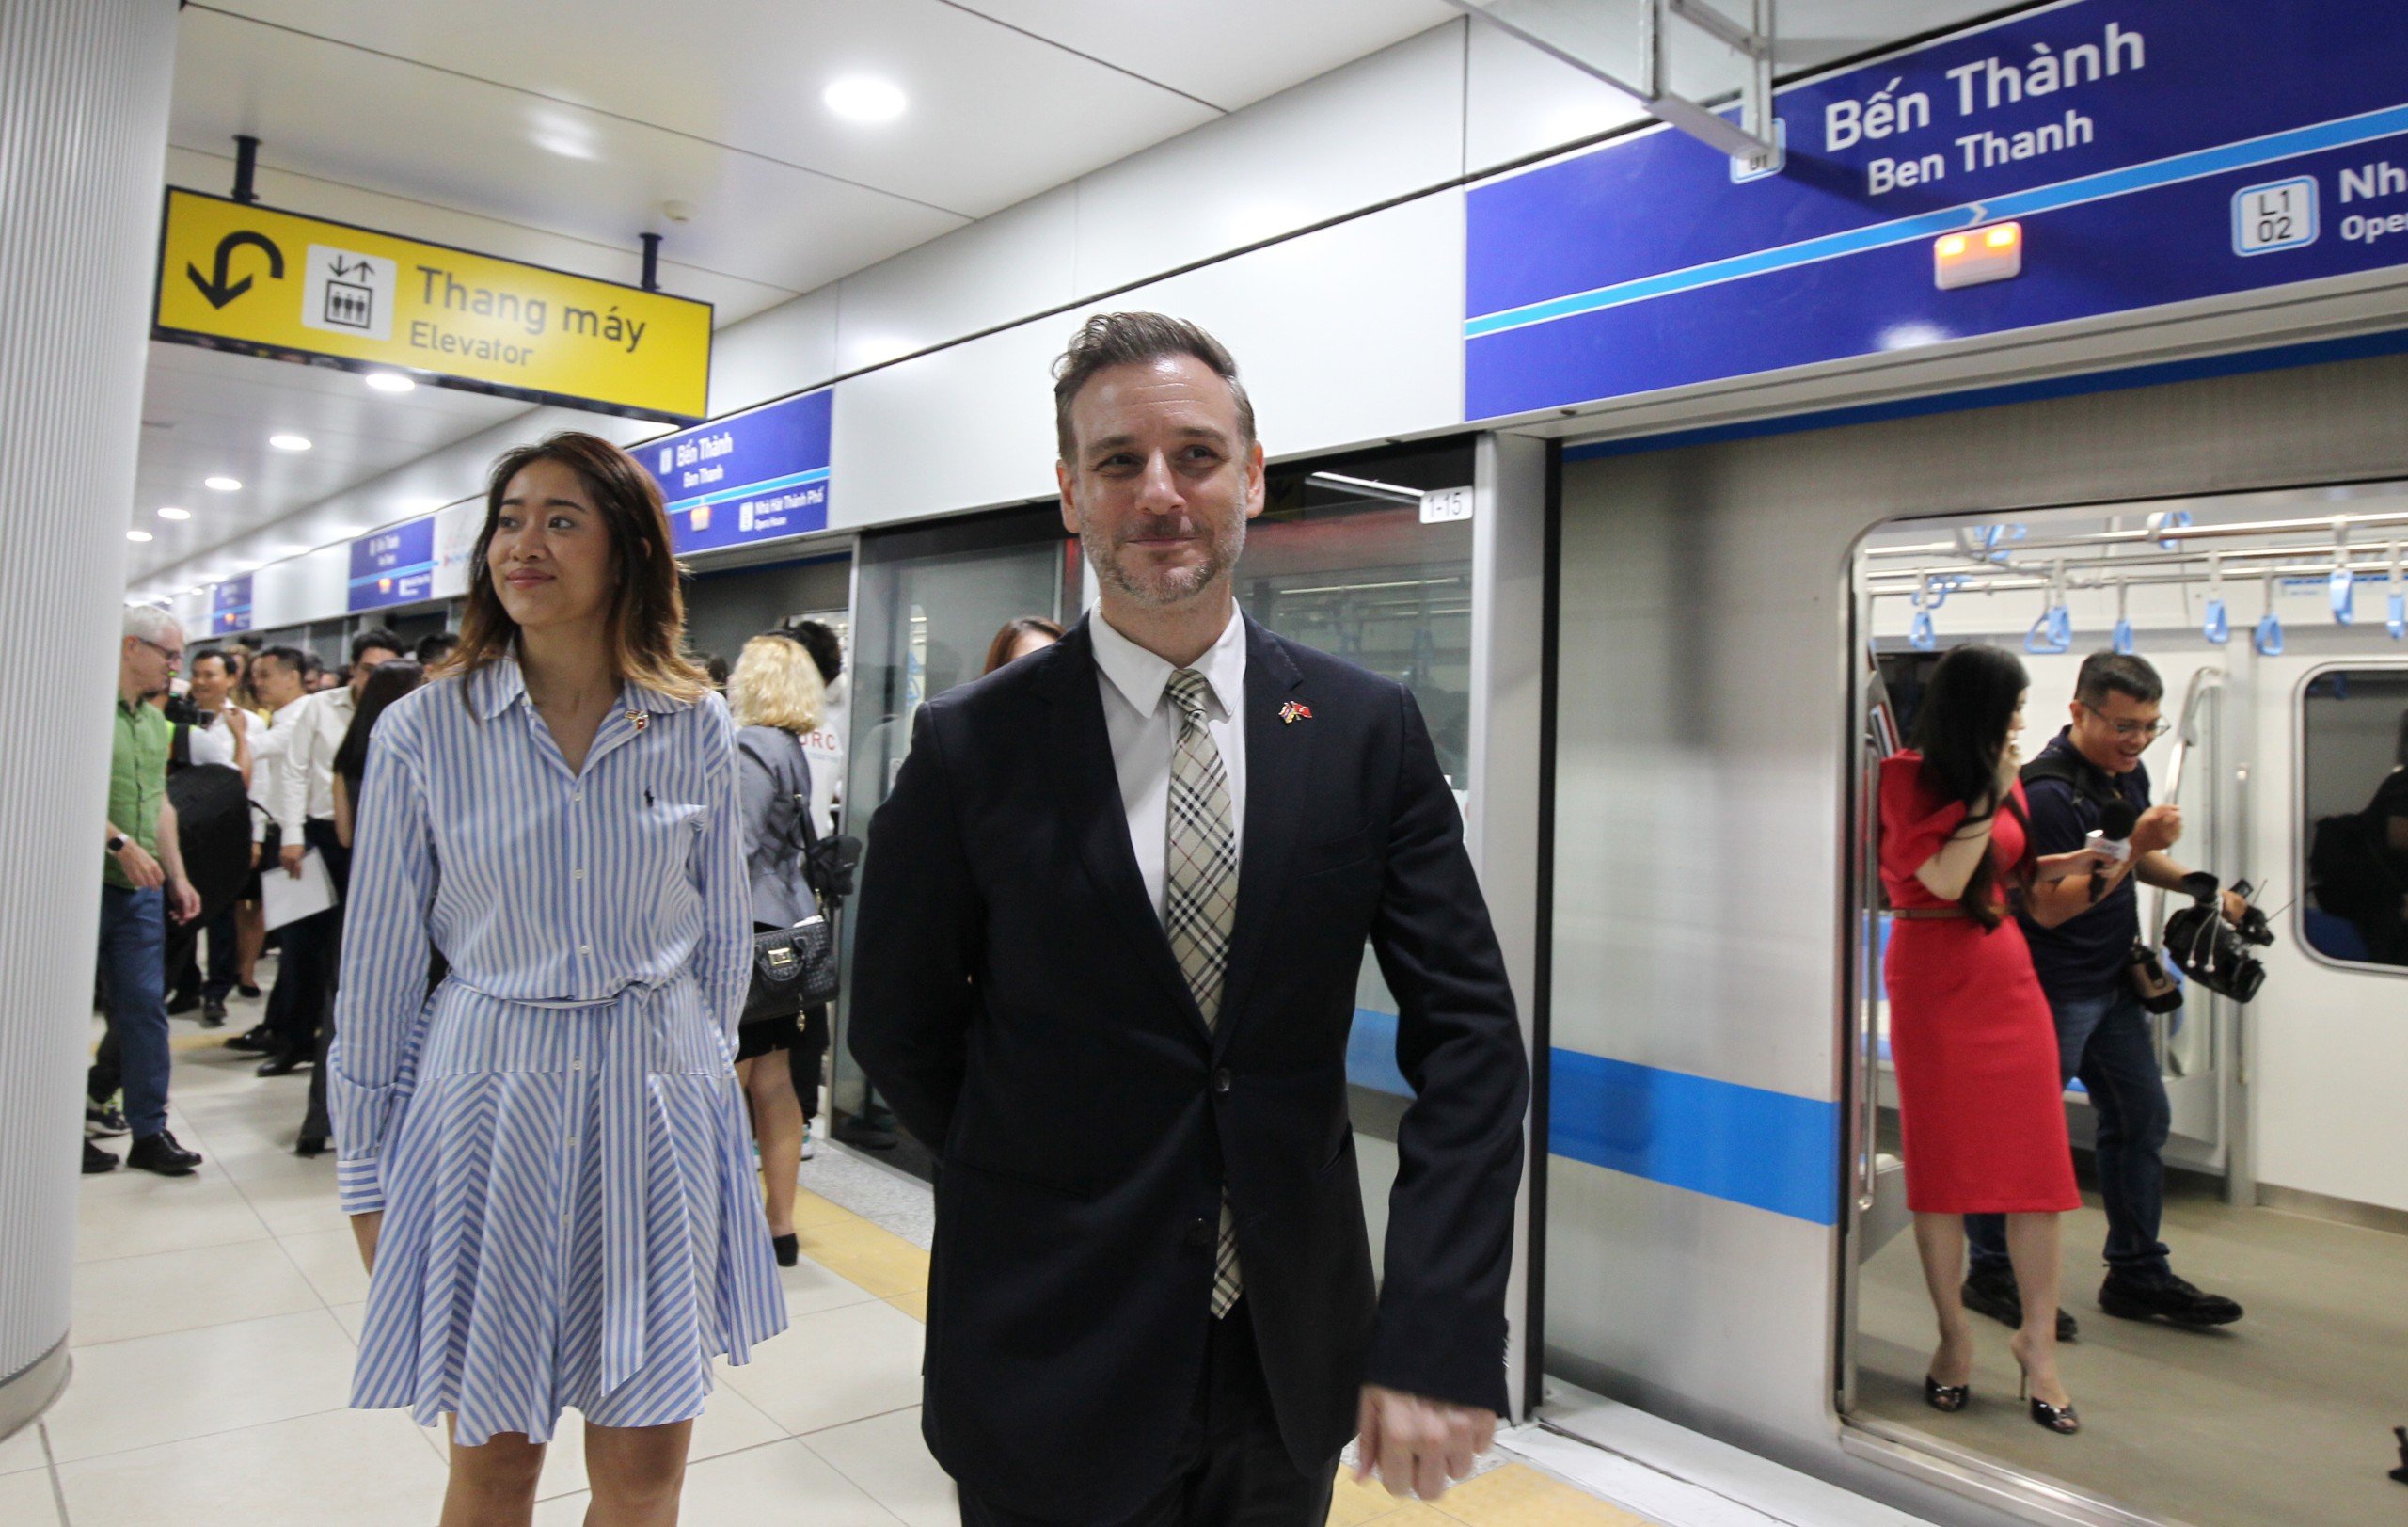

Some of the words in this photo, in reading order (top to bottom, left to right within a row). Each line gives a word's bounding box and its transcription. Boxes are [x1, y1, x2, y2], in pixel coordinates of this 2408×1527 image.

[1825, 76, 1930, 152] Bến
[1945, 22, 2146, 117] Thành
[1868, 153, 1945, 196] Ben
[1954, 109, 2094, 172] Thanh
[2259, 189, 2289, 216] L1
[2258, 216, 2292, 243] 02
[2339, 212, 2408, 244] Ope
[416, 265, 547, 335] Thang
[563, 306, 646, 354] máy
[409, 321, 534, 367] Elevator
[1429, 492, 1463, 518] 1-15
